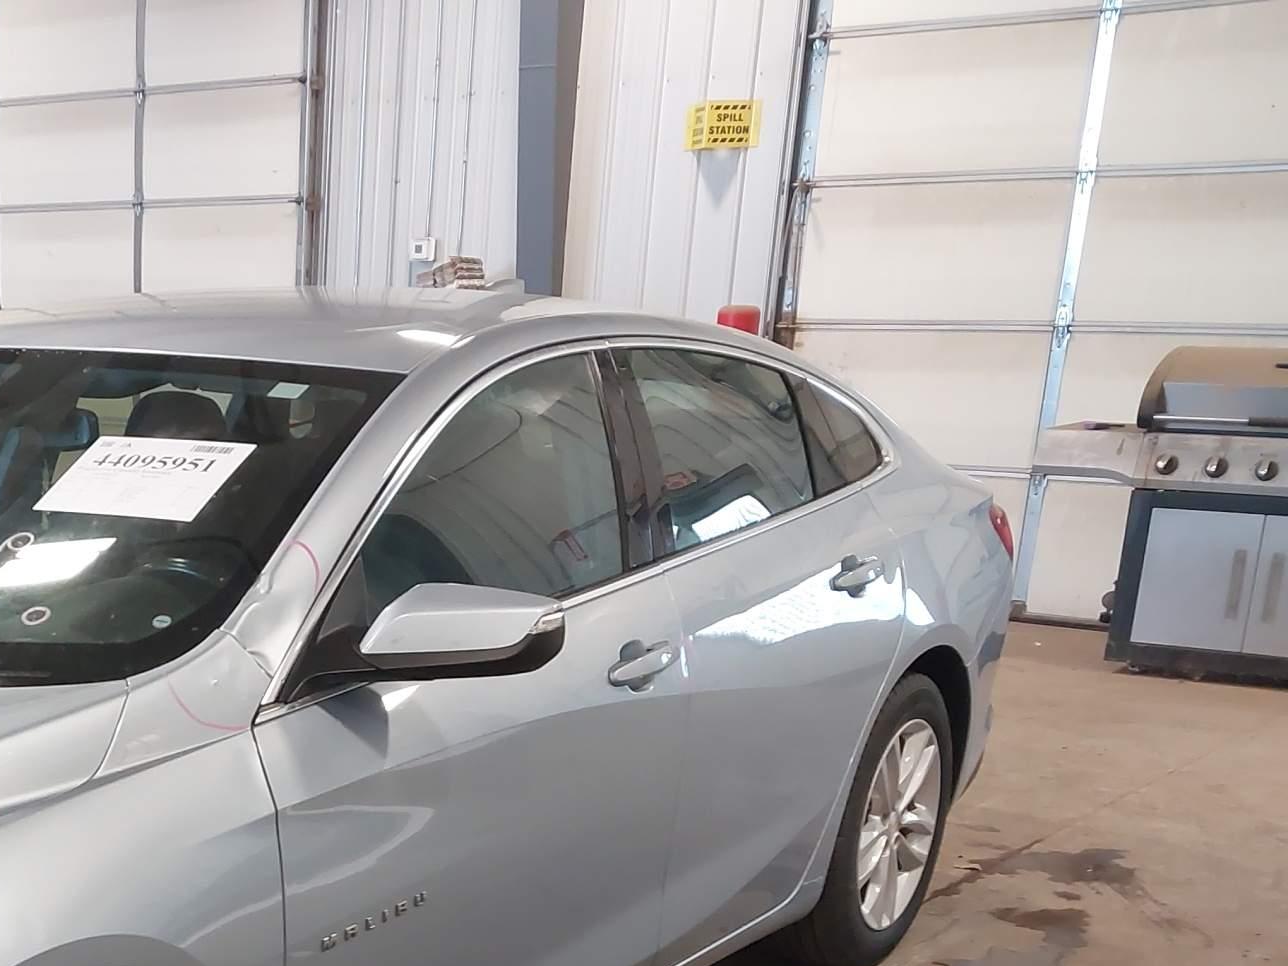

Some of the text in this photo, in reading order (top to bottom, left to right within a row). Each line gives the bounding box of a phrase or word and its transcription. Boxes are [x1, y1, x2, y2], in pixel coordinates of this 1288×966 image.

[716, 113, 744, 122] SPILL
[708, 125, 750, 135] STATION
[93, 453, 217, 473] 44095951
